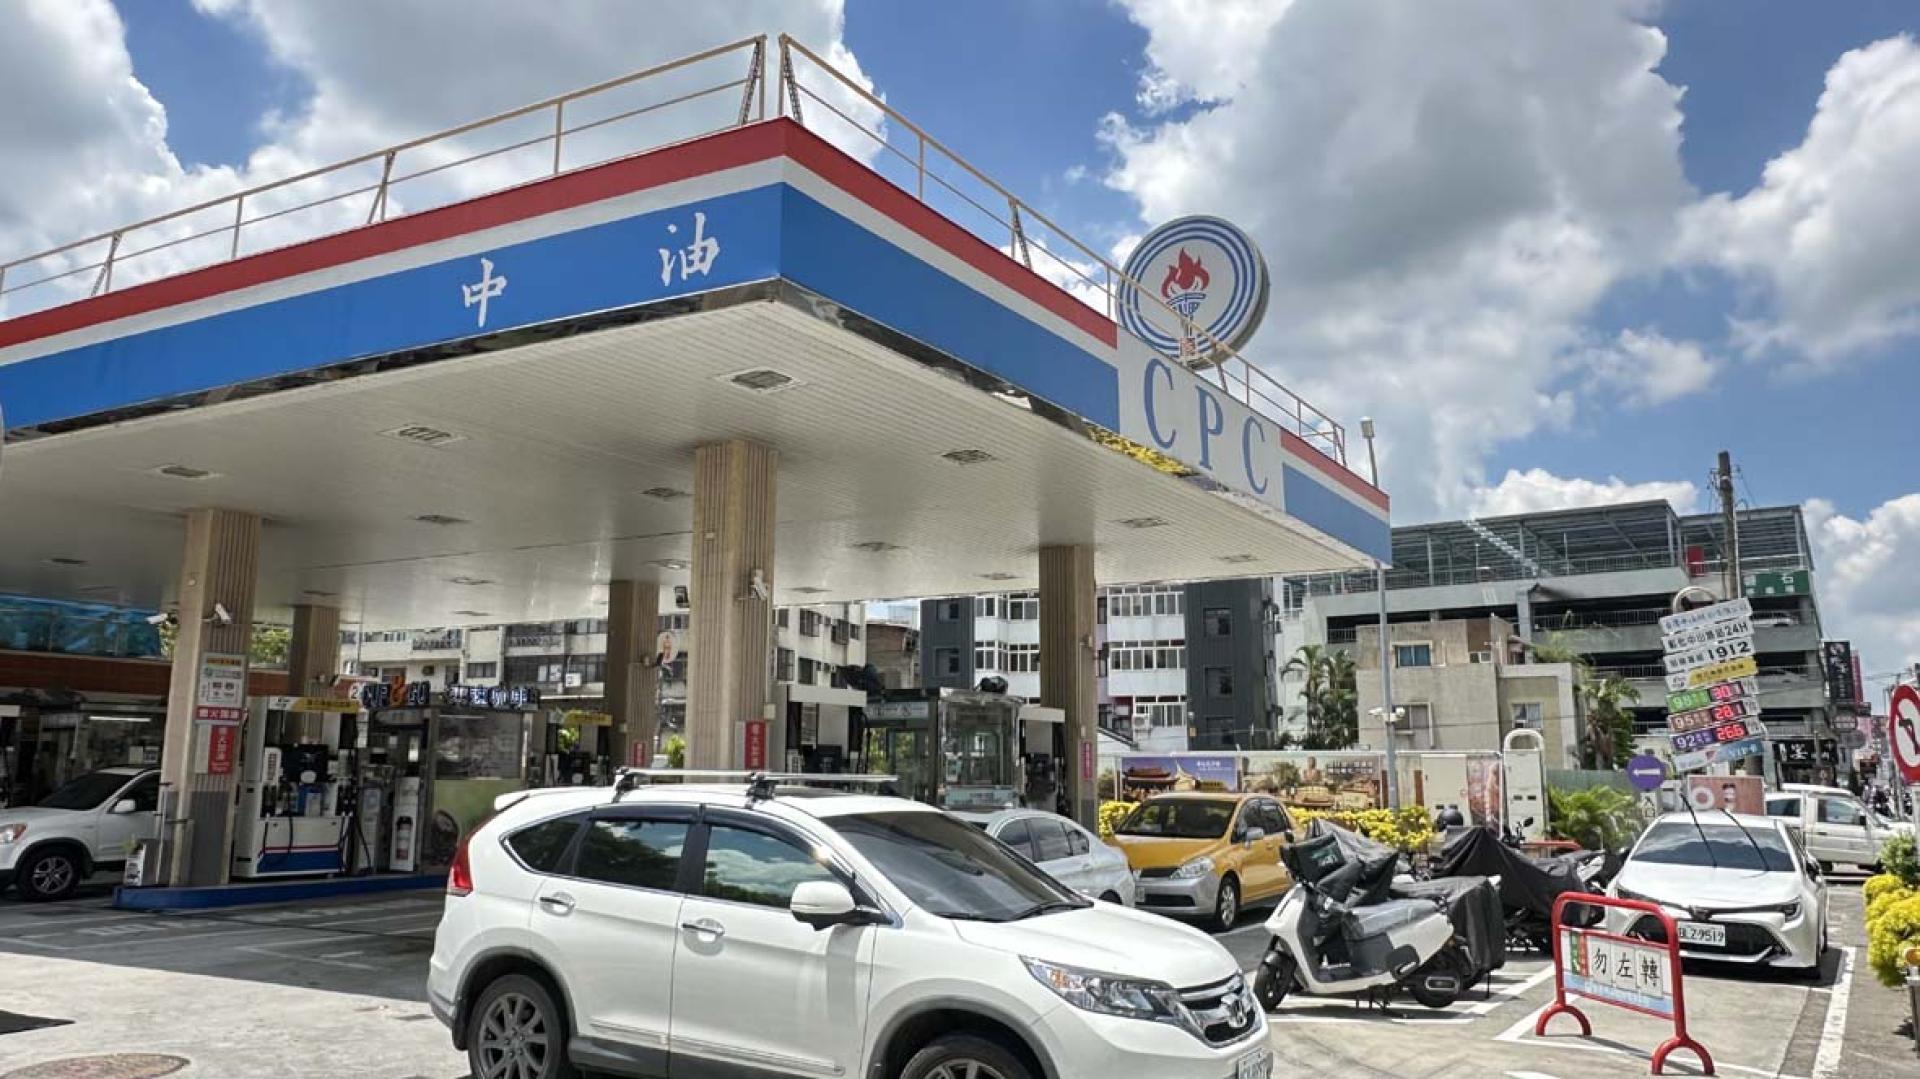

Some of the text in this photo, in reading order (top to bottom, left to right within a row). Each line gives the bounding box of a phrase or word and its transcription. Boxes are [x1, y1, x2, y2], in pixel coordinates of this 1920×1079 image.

[1143, 358, 1268, 494] CPC
[1707, 641, 1751, 660] 1912
[1674, 714, 1694, 728] 95
[1677, 734, 1695, 748] 92
[1594, 948, 1661, 988] 勿左轉
